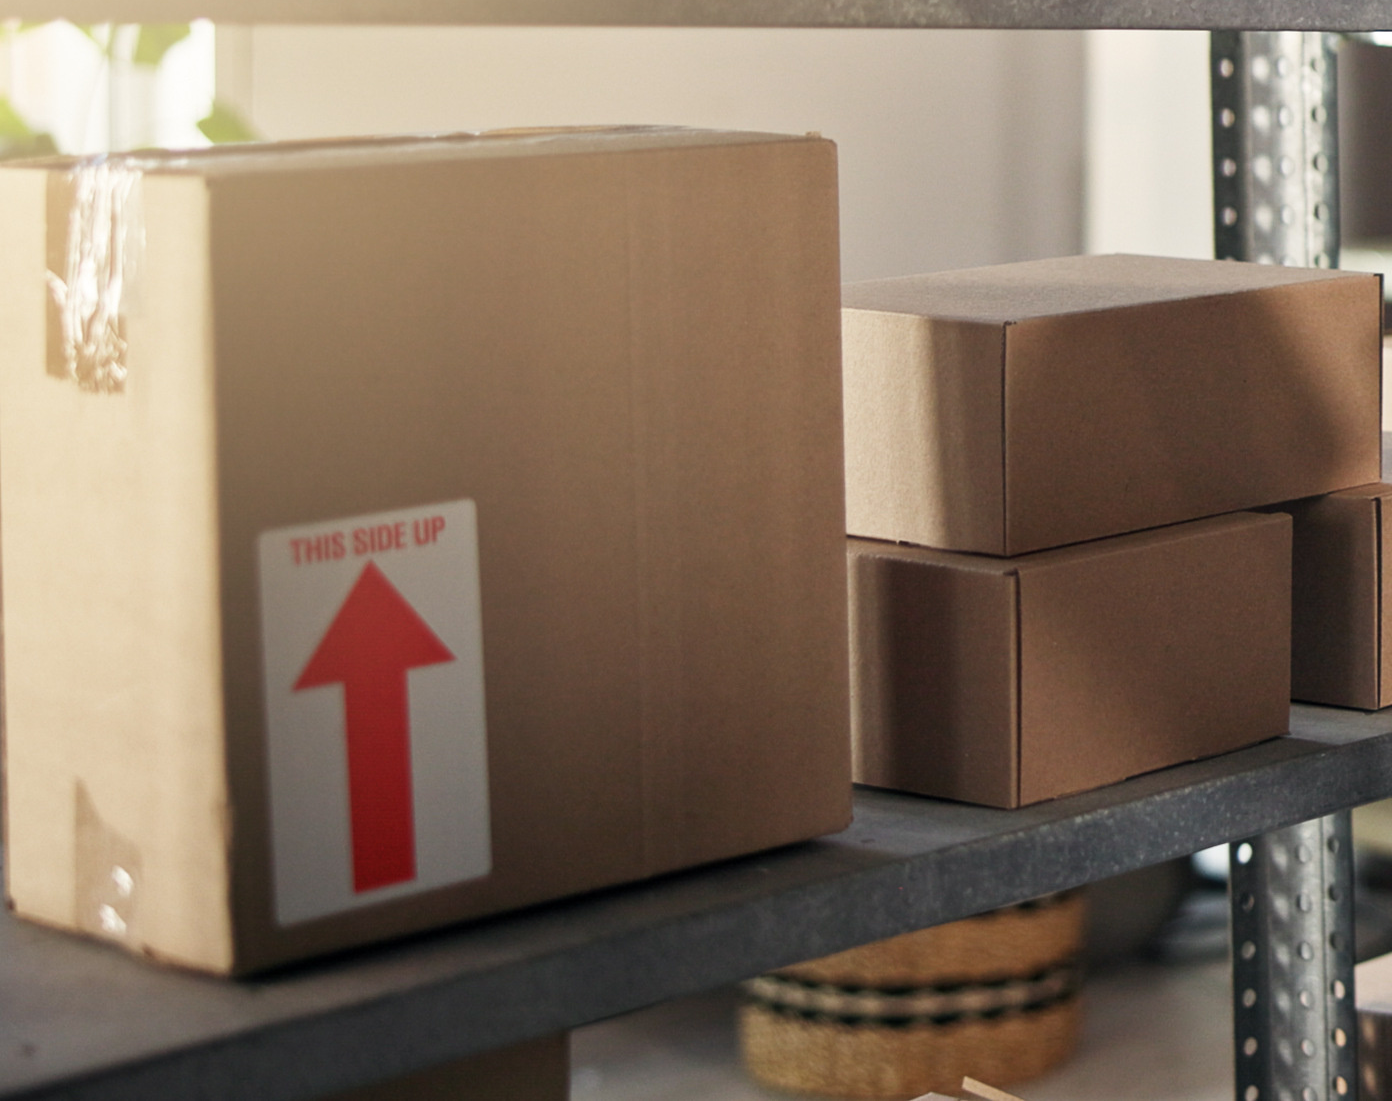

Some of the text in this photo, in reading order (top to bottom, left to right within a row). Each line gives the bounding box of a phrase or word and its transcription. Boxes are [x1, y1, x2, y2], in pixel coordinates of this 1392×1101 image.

[289, 515, 446, 567] THIS SIDE UP
